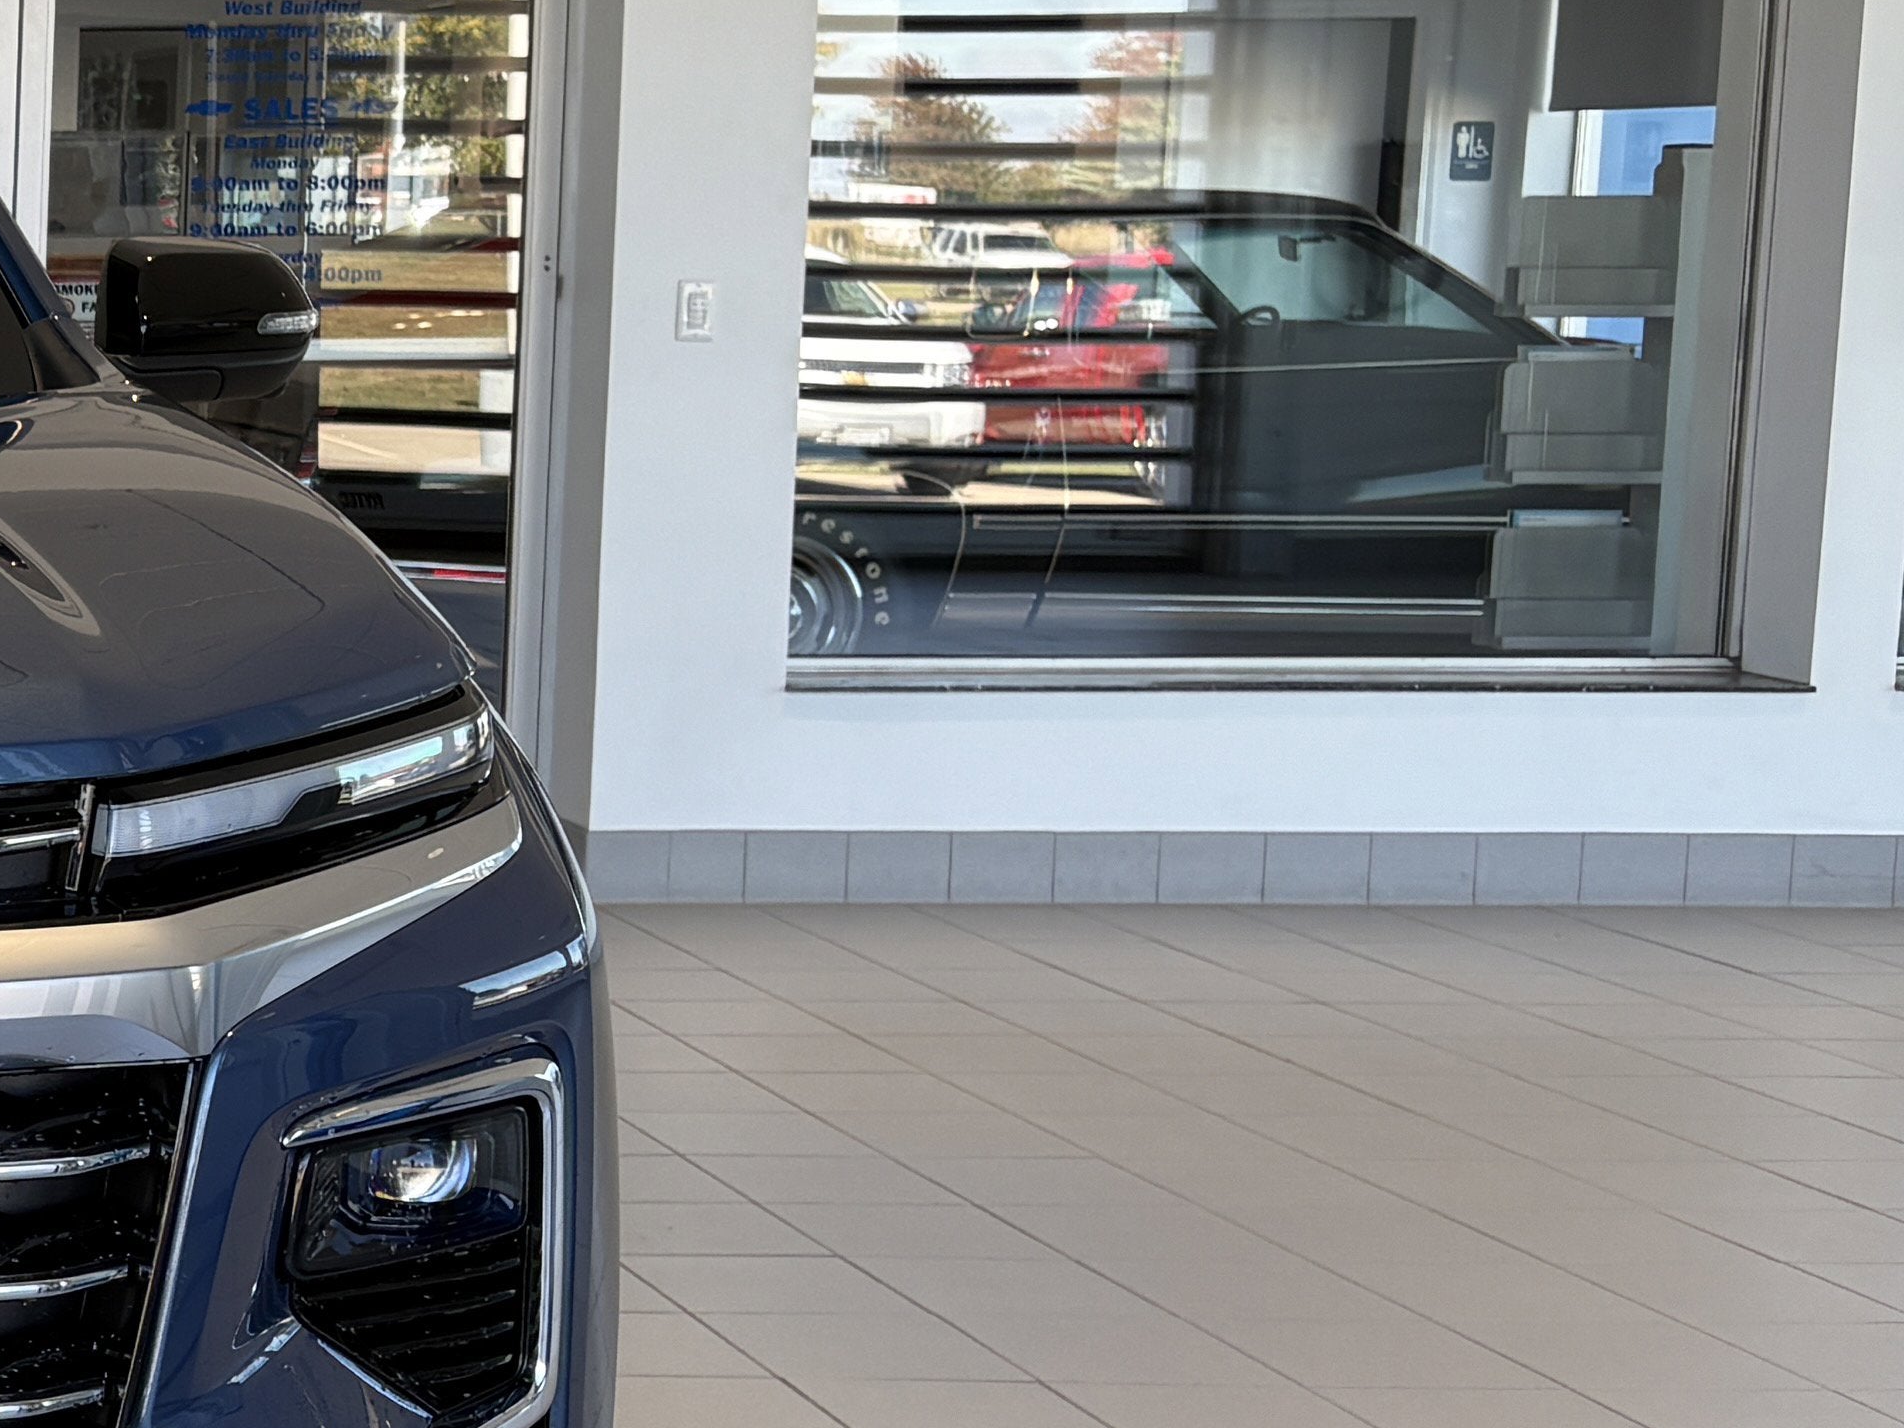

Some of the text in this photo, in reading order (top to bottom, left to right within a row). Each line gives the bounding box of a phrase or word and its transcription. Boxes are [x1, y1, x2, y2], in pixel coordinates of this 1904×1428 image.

[225, 0, 362, 17] West Building
[185, 23, 269, 42] Monday
[244, 98, 339, 122] SALES
[224, 133, 355, 151] East Building
[250, 156, 319, 173] Monday
[278, 176, 298, 192] to
[307, 175, 387, 194] 8:00pm
[189, 221, 384, 239] 9:00am to 6:00pm
